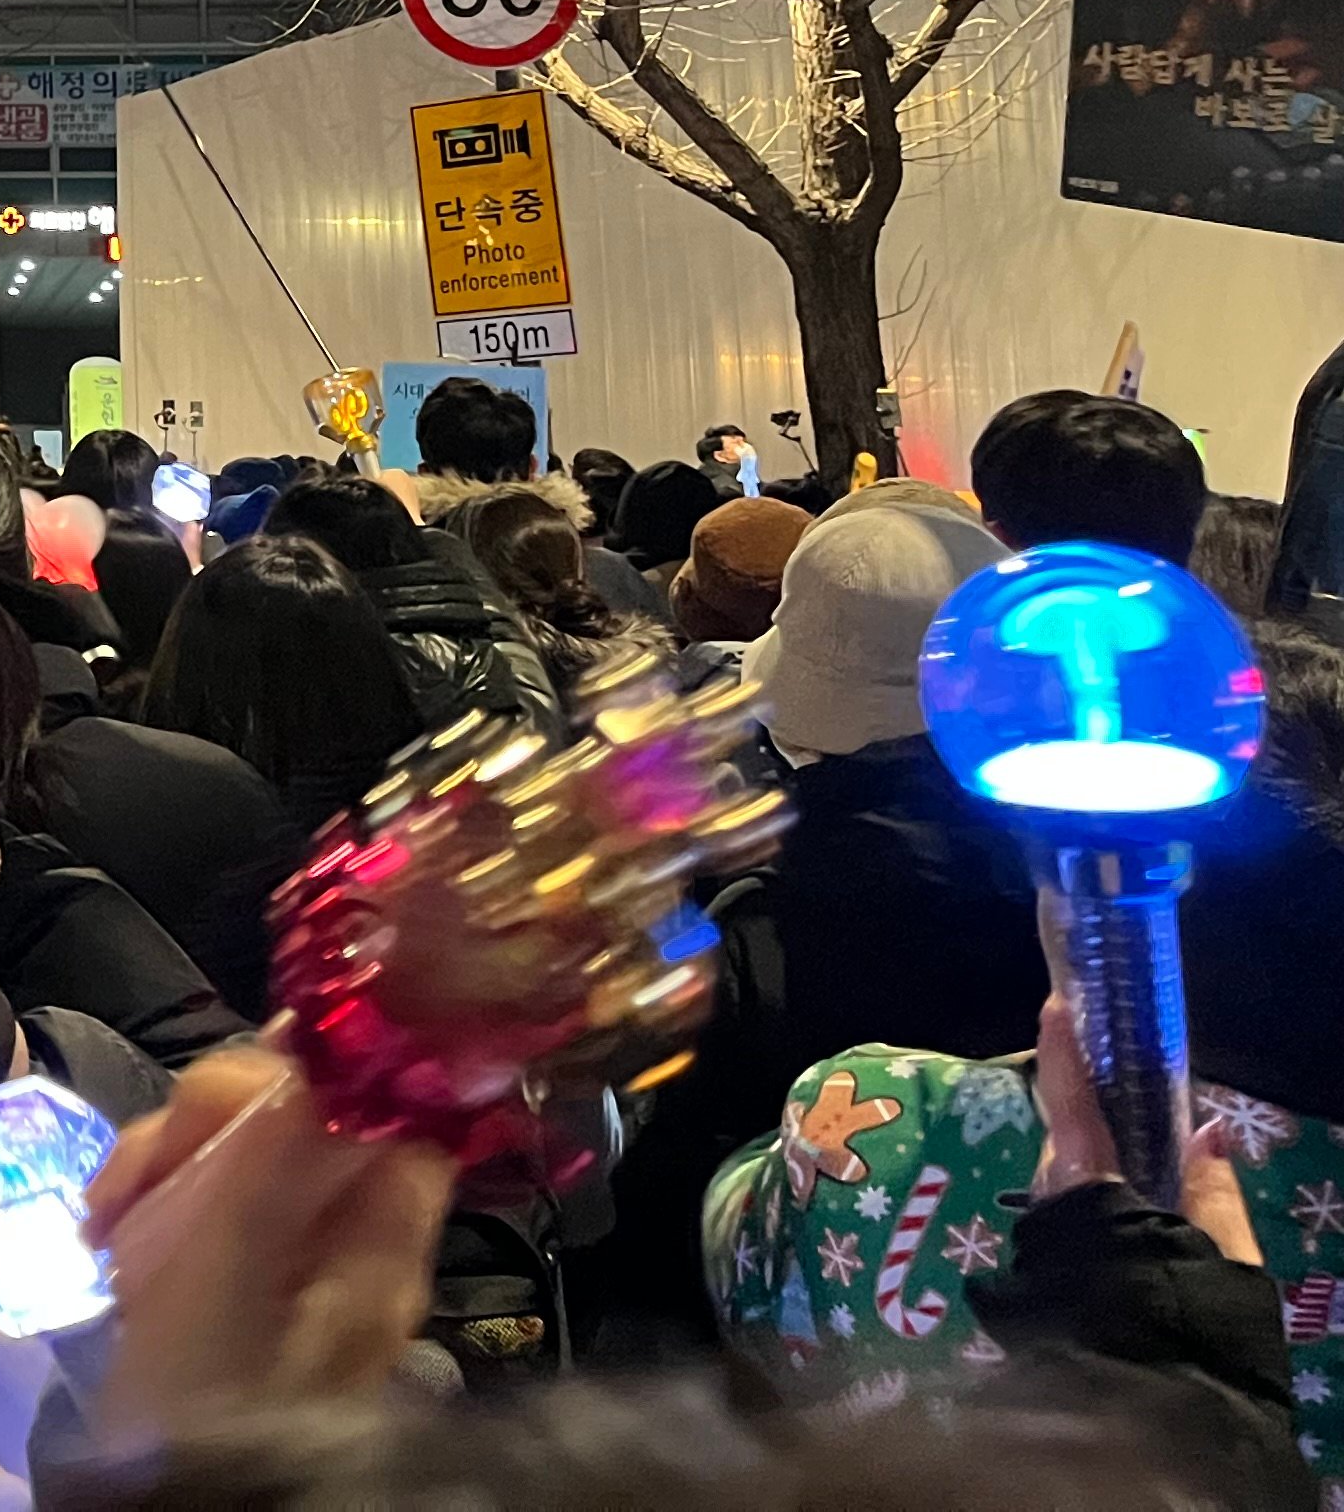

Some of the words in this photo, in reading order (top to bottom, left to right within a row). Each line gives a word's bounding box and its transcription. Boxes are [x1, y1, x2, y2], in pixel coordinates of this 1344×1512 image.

[435, 187, 544, 233] 단속중
[463, 241, 525, 266] Photo
[439, 264, 560, 294] enforcement
[469, 320, 550, 354] 150m
